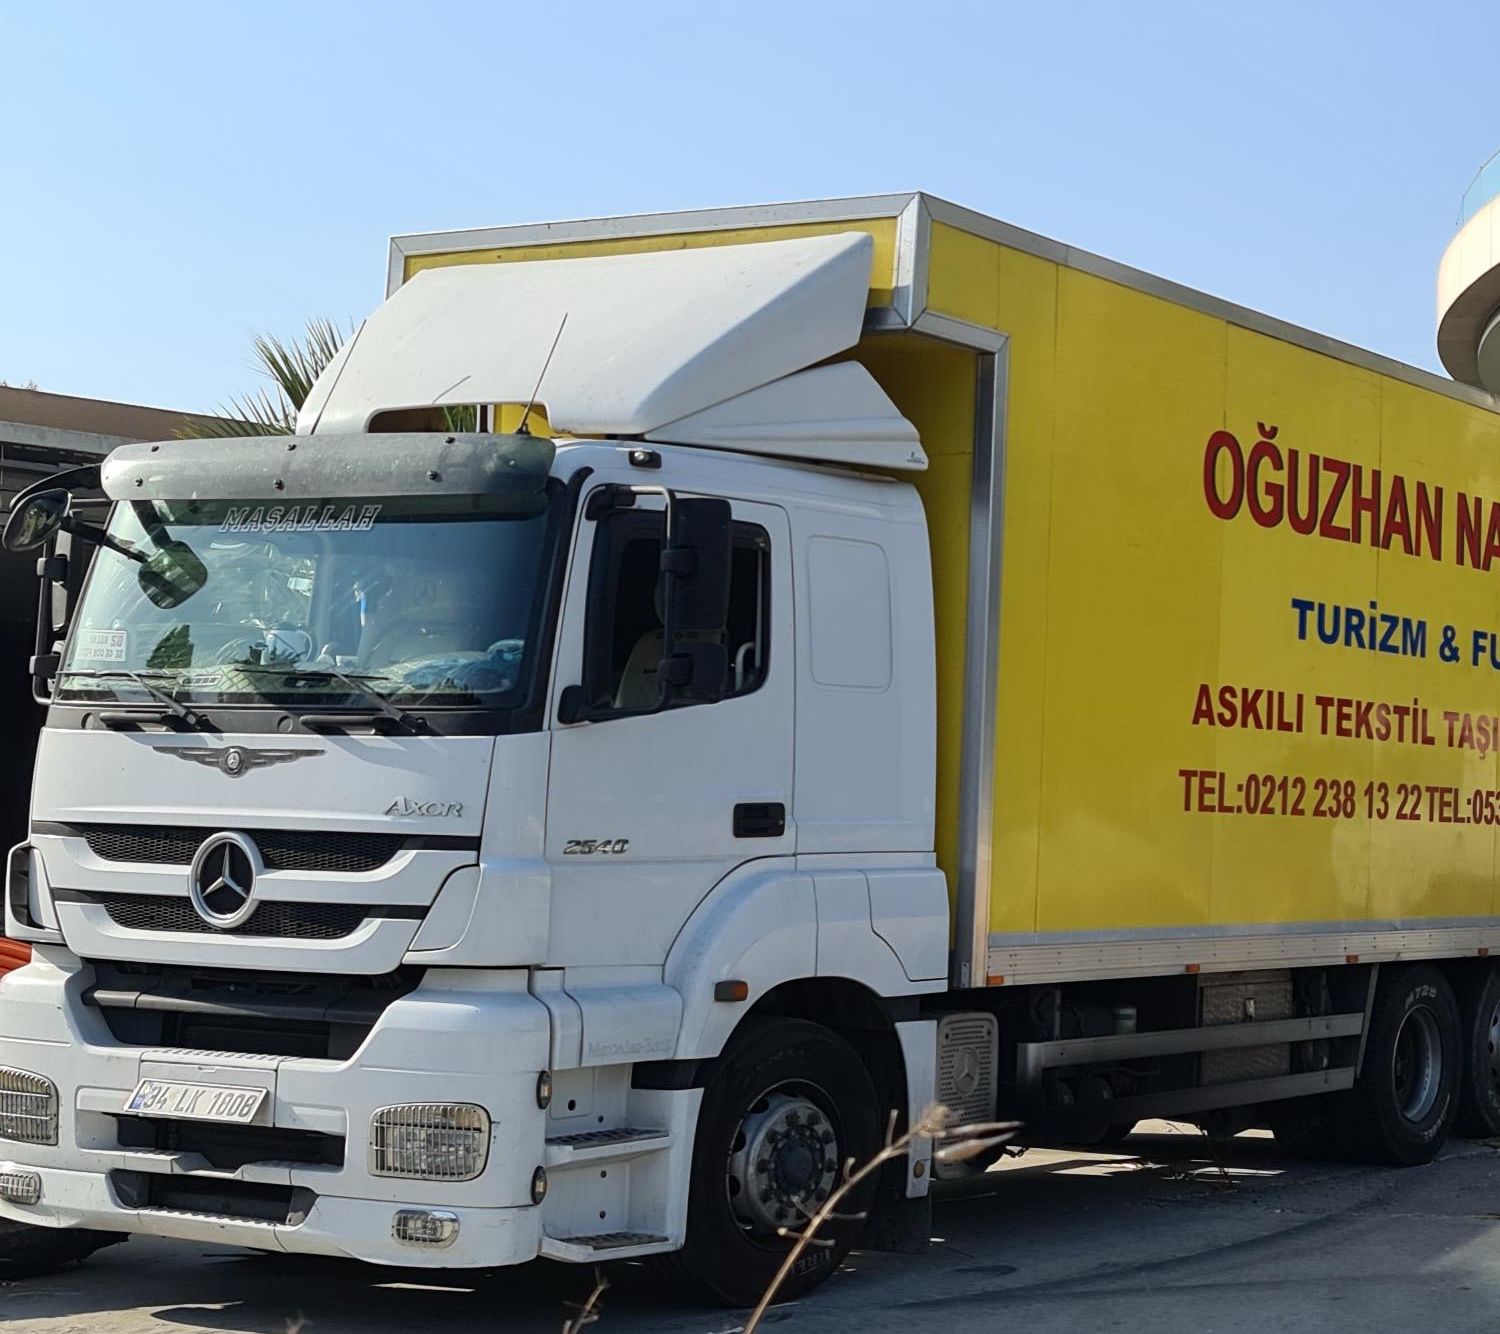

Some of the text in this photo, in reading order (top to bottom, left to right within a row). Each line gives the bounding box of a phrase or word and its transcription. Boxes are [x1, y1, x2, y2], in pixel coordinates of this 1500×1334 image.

[1203, 421, 1443, 562] OĞUZHAN
[218, 504, 383, 534] MAŞALLAH
[1291, 598, 1427, 658] TURİZM
[1439, 625, 1460, 663] &
[1192, 683, 1304, 733] ASKILI
[1315, 696, 1436, 746] TEKSTİL
[1179, 769, 1306, 816] TEL:0212
[1312, 778, 1356, 819] 238
[1364, 781, 1390, 820] 13
[1395, 783, 1422, 821] 22
[562, 838, 630, 855] 2540
[143, 1085, 170, 1110] 34
[173, 1088, 206, 1114] LK
